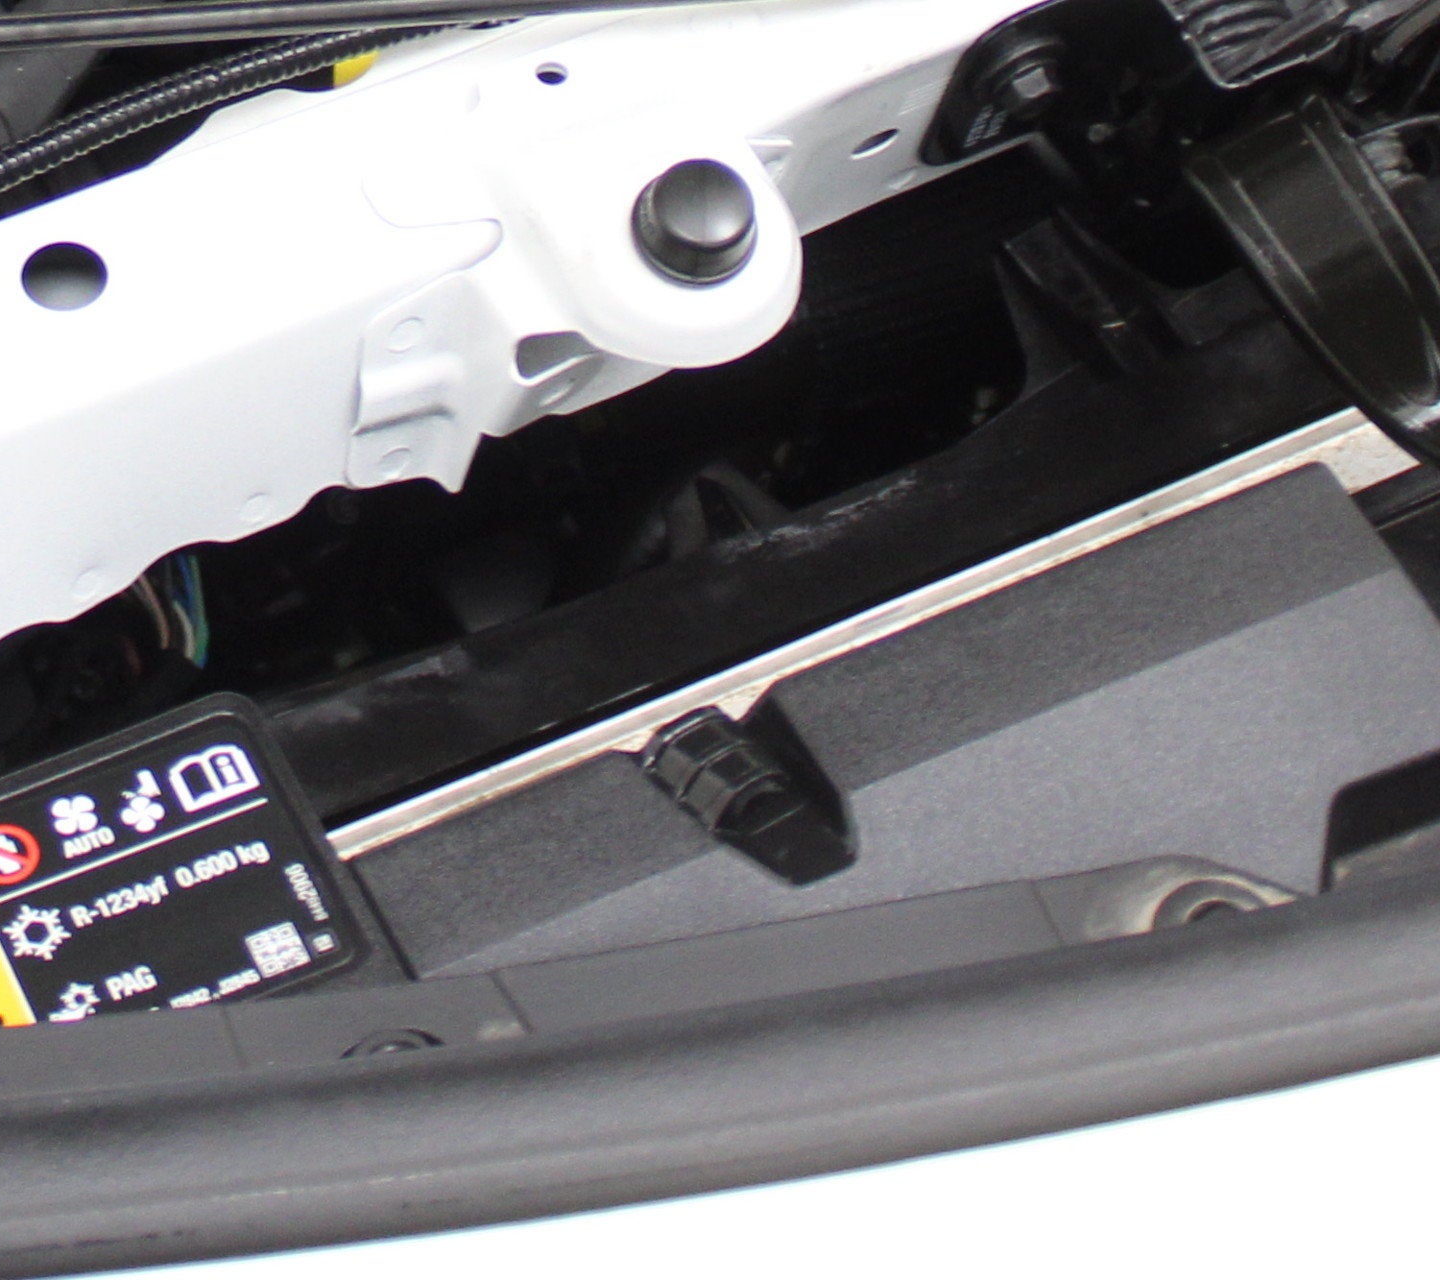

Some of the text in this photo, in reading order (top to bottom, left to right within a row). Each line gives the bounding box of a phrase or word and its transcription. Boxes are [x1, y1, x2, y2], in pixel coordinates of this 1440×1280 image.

[63, 826, 115, 859] AUTO
[69, 841, 270, 928] R-1234yf 0.600 kg
[105, 965, 158, 1001] PAG
